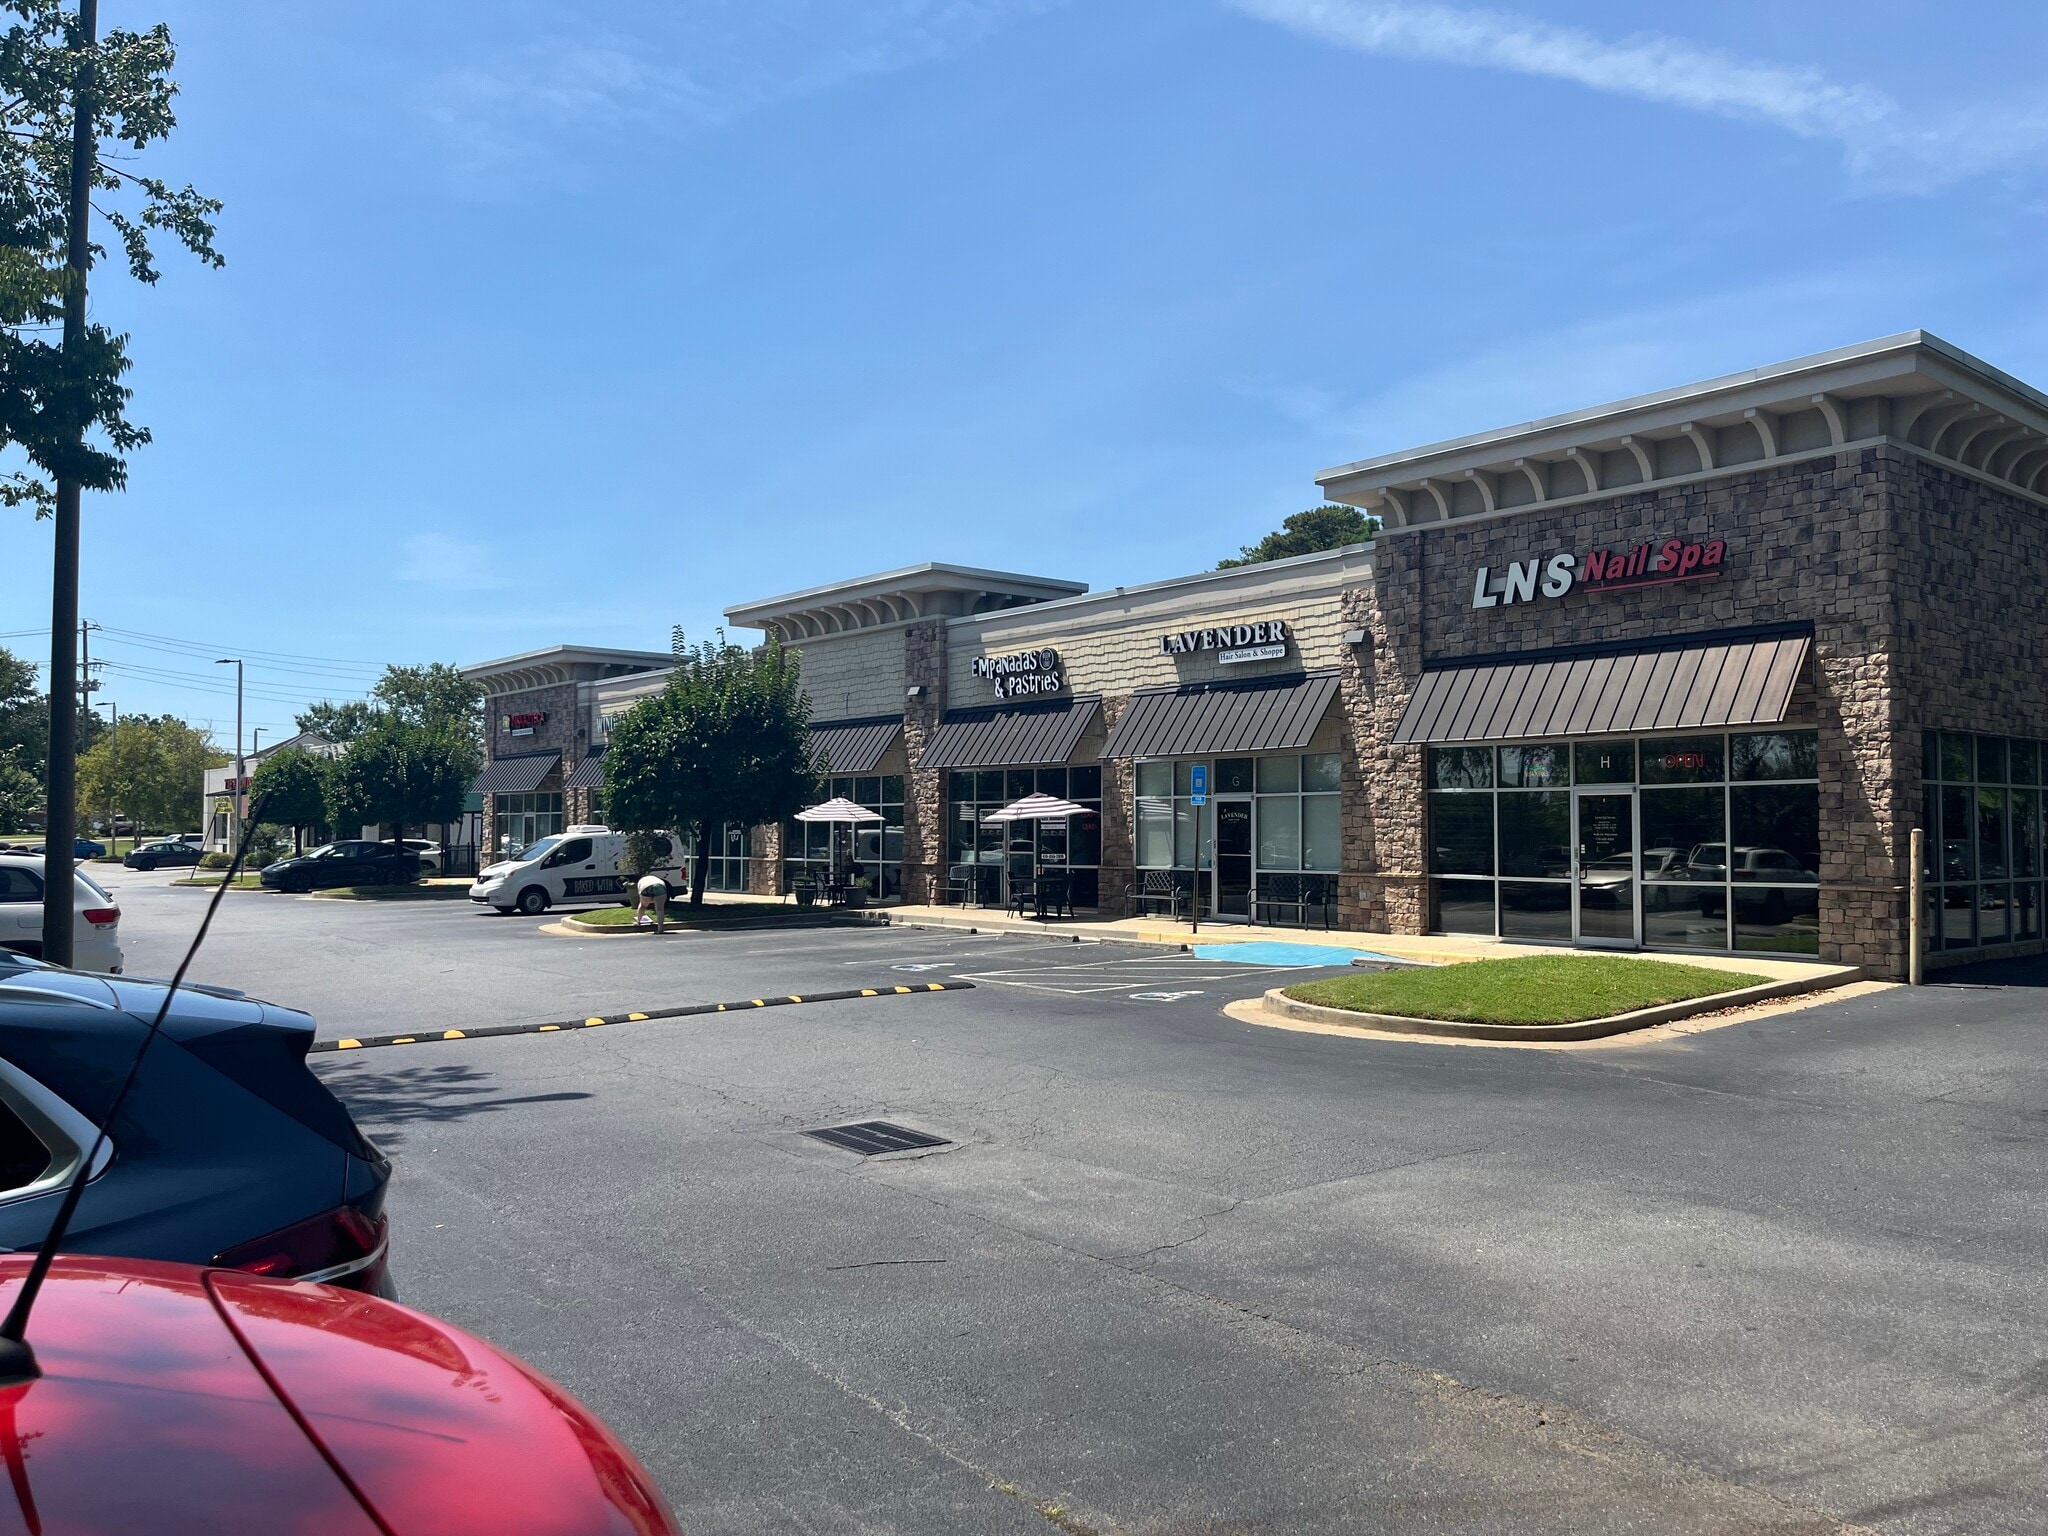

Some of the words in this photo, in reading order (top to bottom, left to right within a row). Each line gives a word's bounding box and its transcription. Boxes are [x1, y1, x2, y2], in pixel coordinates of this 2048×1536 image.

[1472, 553, 1577, 609] LNS
[1582, 544, 1652, 582] Nail
[1657, 539, 1727, 576] Spa
[1159, 620, 1286, 655] LAVENDER
[1219, 652, 1233, 661] Hair
[1234, 650, 1251, 659] Salon
[1252, 649, 1259, 657] &
[1260, 647, 1284, 658] Shoppe
[994, 677, 1004, 698] &
[1600, 756, 1610, 769] H
[1664, 754, 1705, 768] OPEN
[1232, 775, 1240, 787] G
[1220, 812, 1249, 820] LAVENDER
[597, 878, 614, 892] WITH
